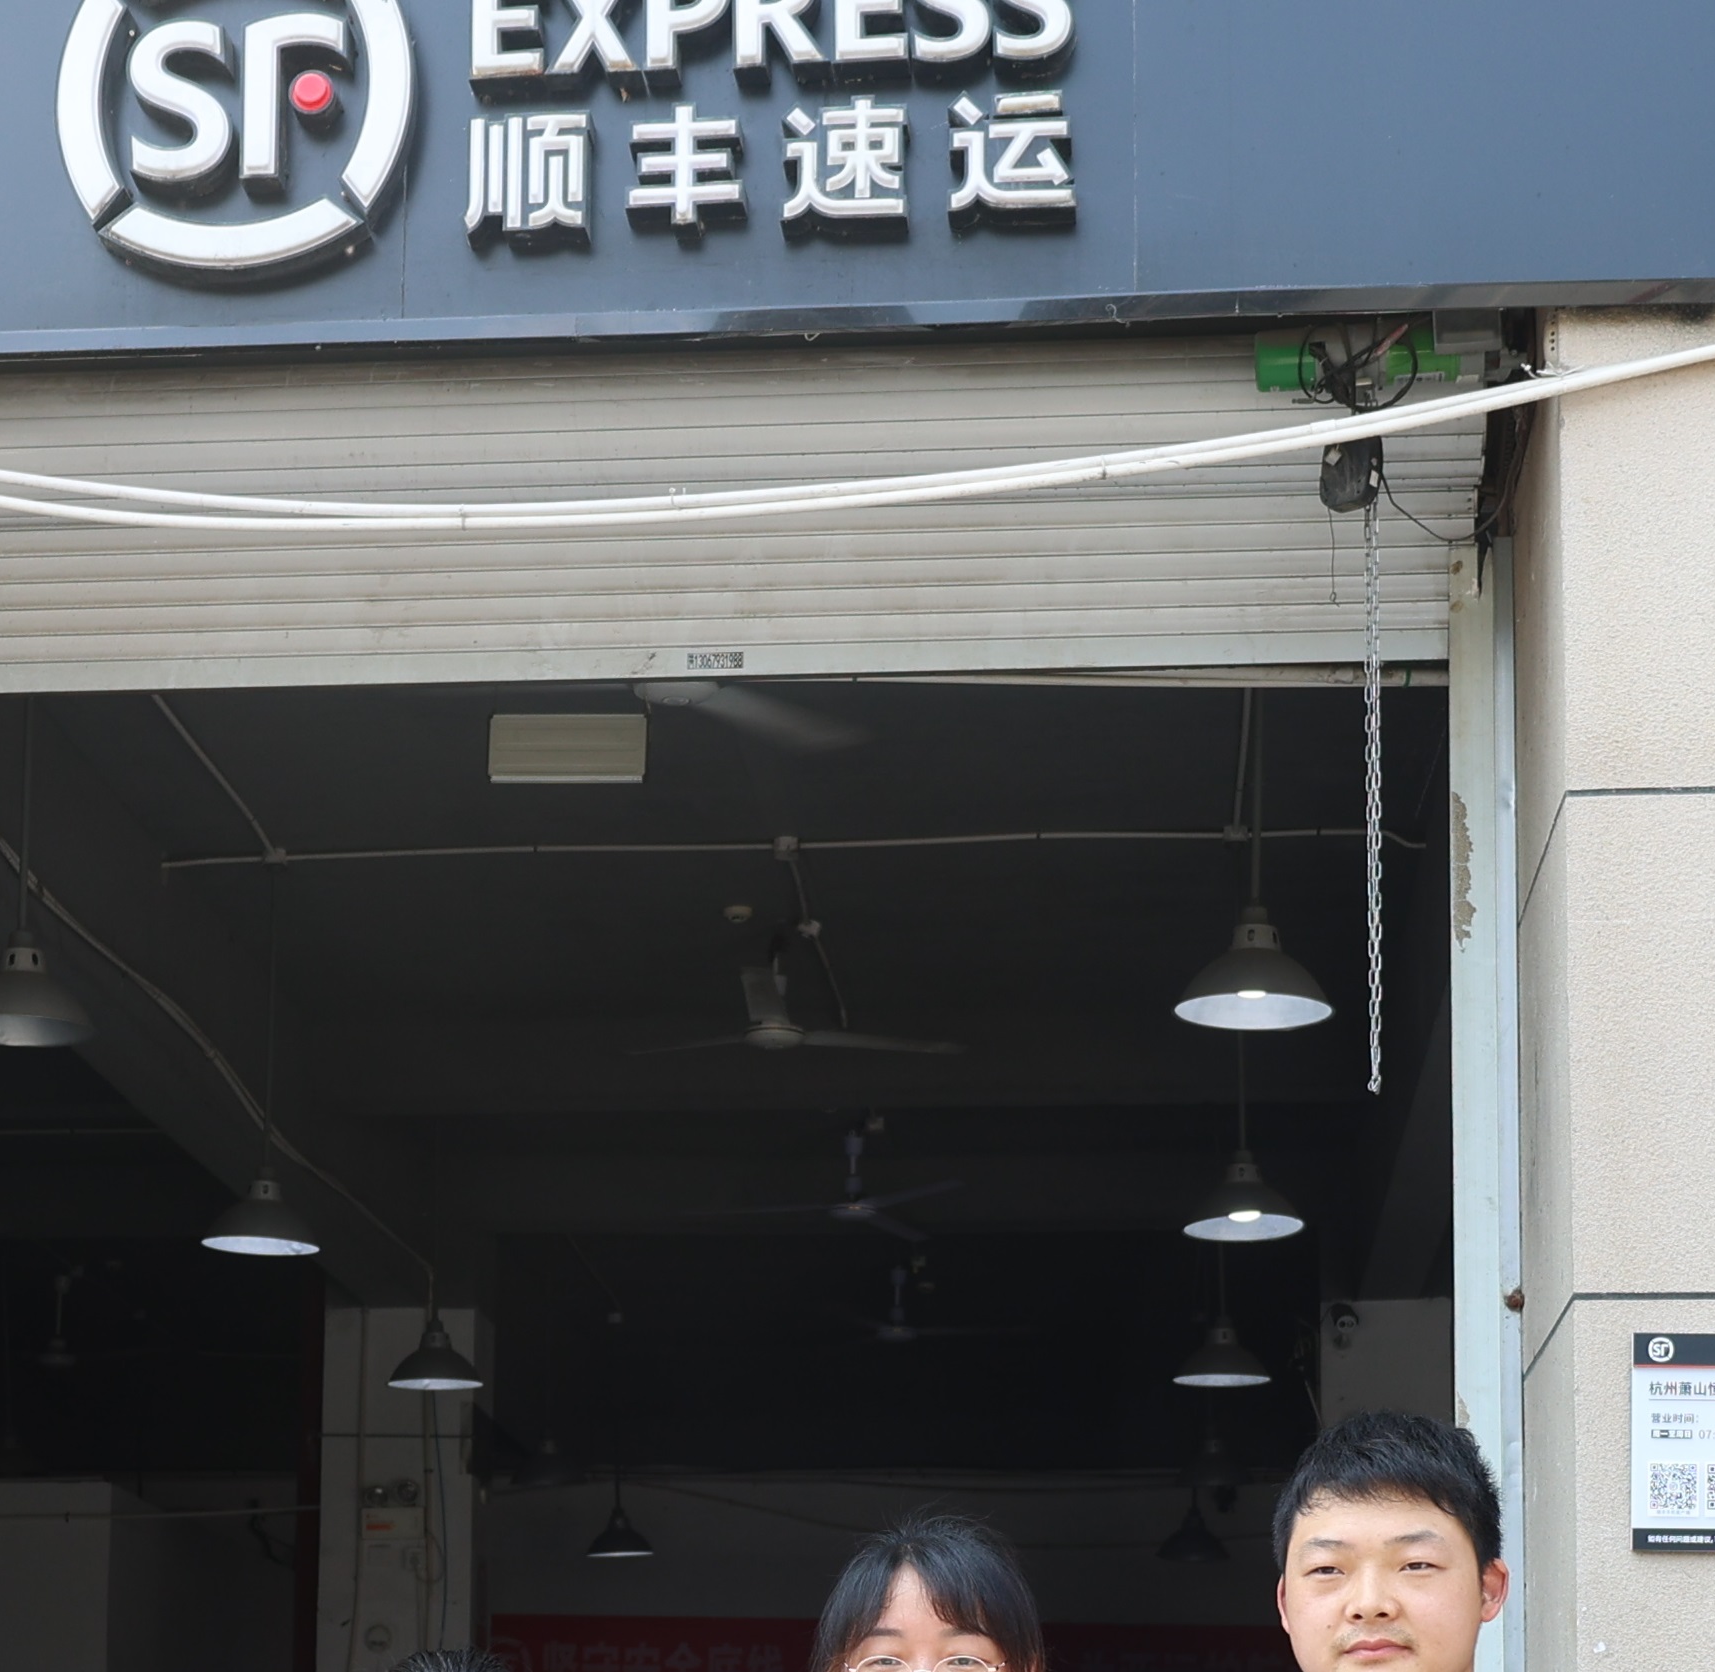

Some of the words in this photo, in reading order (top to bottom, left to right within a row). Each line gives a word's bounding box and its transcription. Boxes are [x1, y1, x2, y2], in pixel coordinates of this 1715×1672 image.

[471, 0, 1076, 78] EXPRESS
[466, 94, 1076, 232] 顺丰速运
